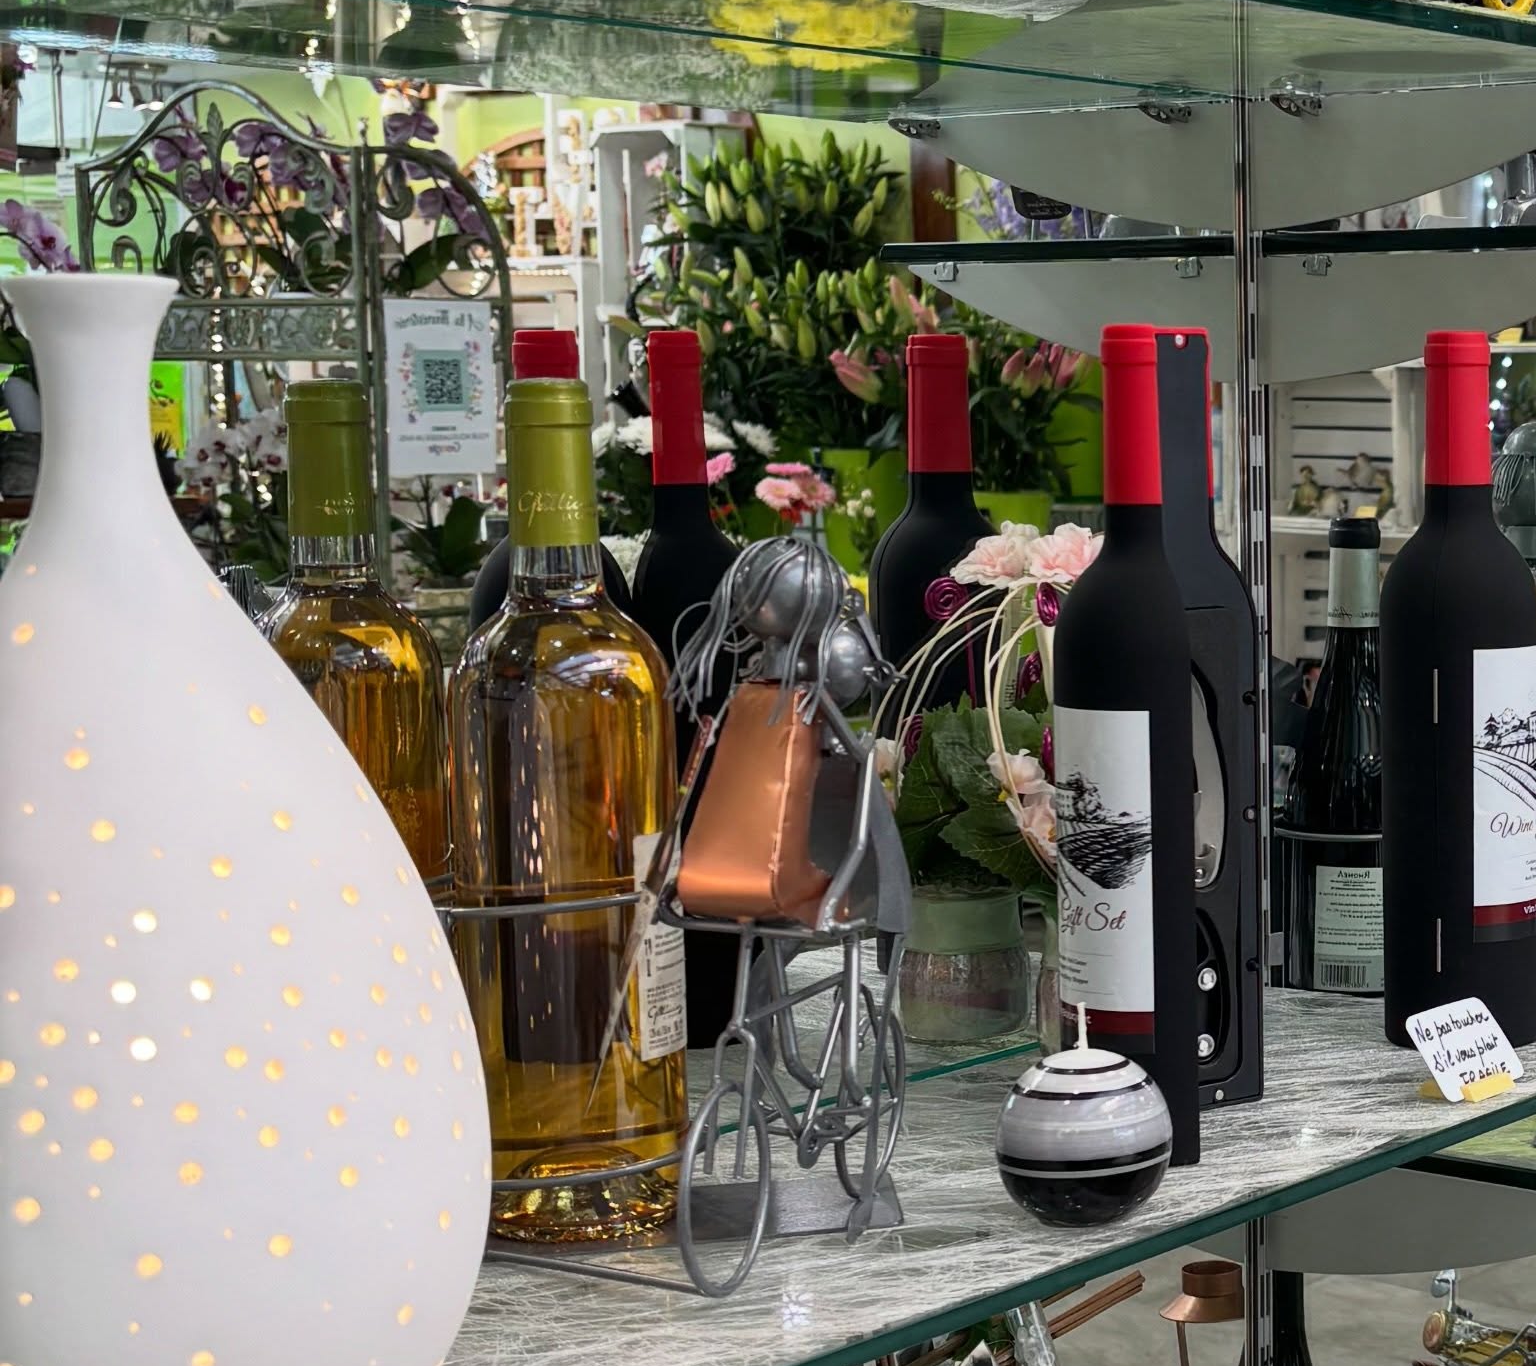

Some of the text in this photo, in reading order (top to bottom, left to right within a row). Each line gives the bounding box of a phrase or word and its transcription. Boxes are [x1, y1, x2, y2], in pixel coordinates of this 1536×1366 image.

[1490, 812, 1534, 839] Wine
[1084, 901, 1127, 932] Set
[1415, 1018, 1434, 1045] Ne
[1433, 1020, 1452, 1052] pas
[1455, 1047, 1477, 1063] vous
